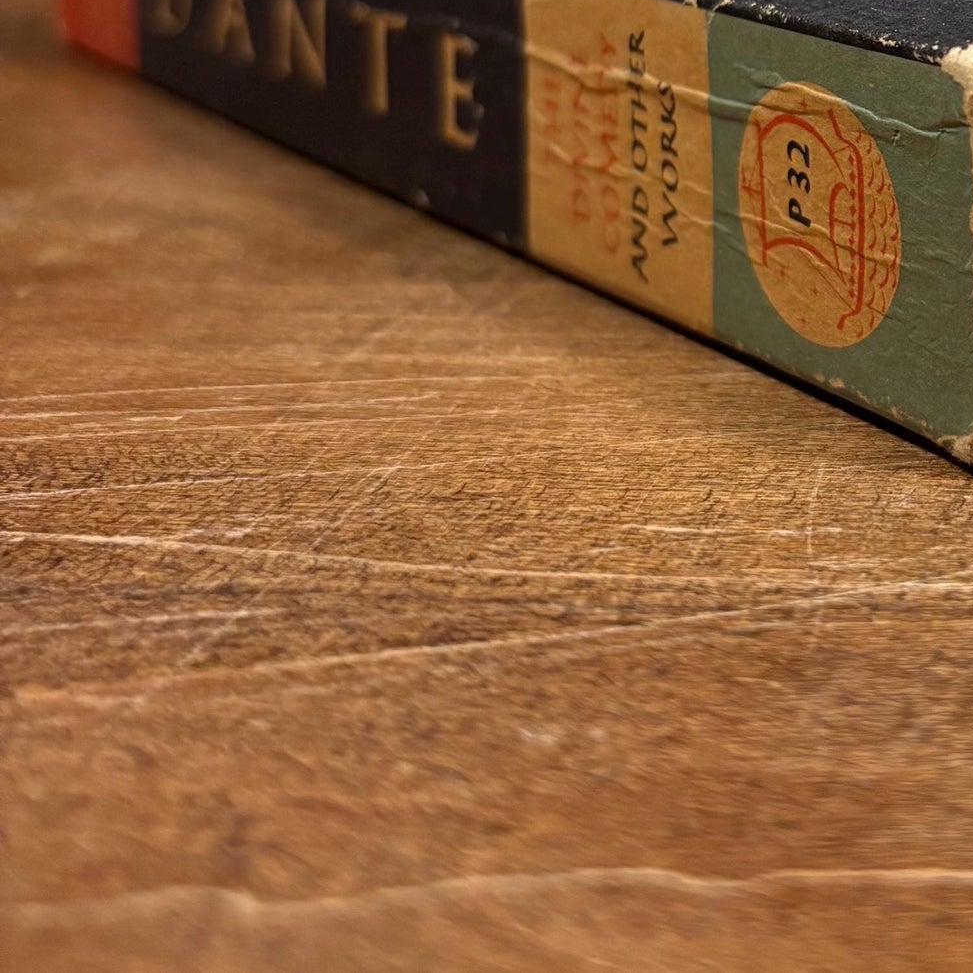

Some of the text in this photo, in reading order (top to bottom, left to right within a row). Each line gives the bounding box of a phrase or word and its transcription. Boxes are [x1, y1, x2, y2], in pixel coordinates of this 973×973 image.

[572, 53, 591, 222] DIVINE
[599, 31, 621, 254] COMEDY
[627, 29, 649, 284] AND OTHER
[657, 81, 680, 247] WORKS
